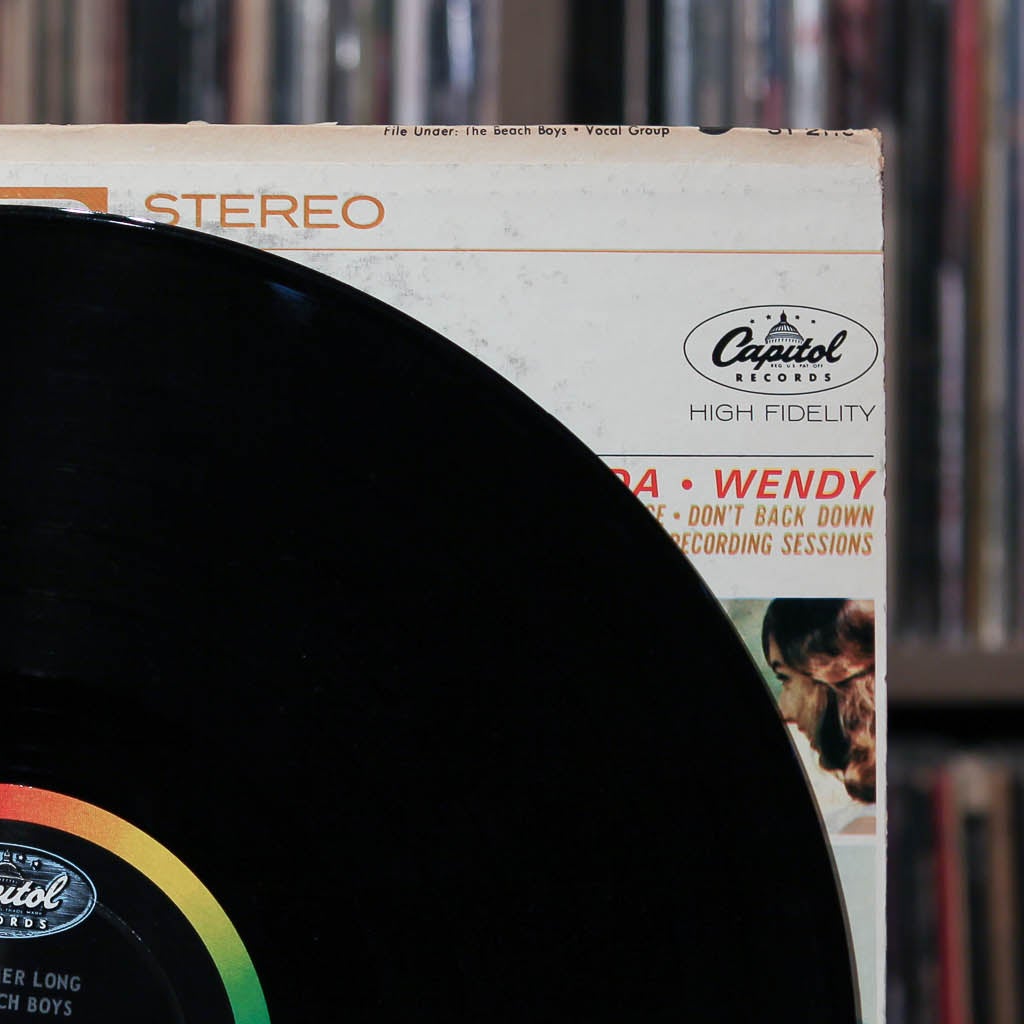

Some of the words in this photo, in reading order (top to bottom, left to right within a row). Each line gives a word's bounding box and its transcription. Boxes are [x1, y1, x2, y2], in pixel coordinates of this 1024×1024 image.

[493, 125, 532, 136] Beach
[538, 125, 567, 138] Boys
[586, 126, 622, 136] Vocal
[628, 126, 670, 138] Group
[145, 193, 385, 230] STEREO
[712, 323, 848, 371] Capitol
[736, 373, 832, 383] RECORDS
[690, 404, 754, 422] HIGH
[765, 405, 876, 422] FIDELITY
[714, 468, 876, 500] WENDY
[687, 503, 745, 528] DON'T
[754, 504, 805, 528] BACK
[817, 505, 874, 528] DOWN
[781, 532, 874, 557] SESSIONS
[32, 970, 82, 992] LONG
[27, 996, 73, 1017] BOYS
